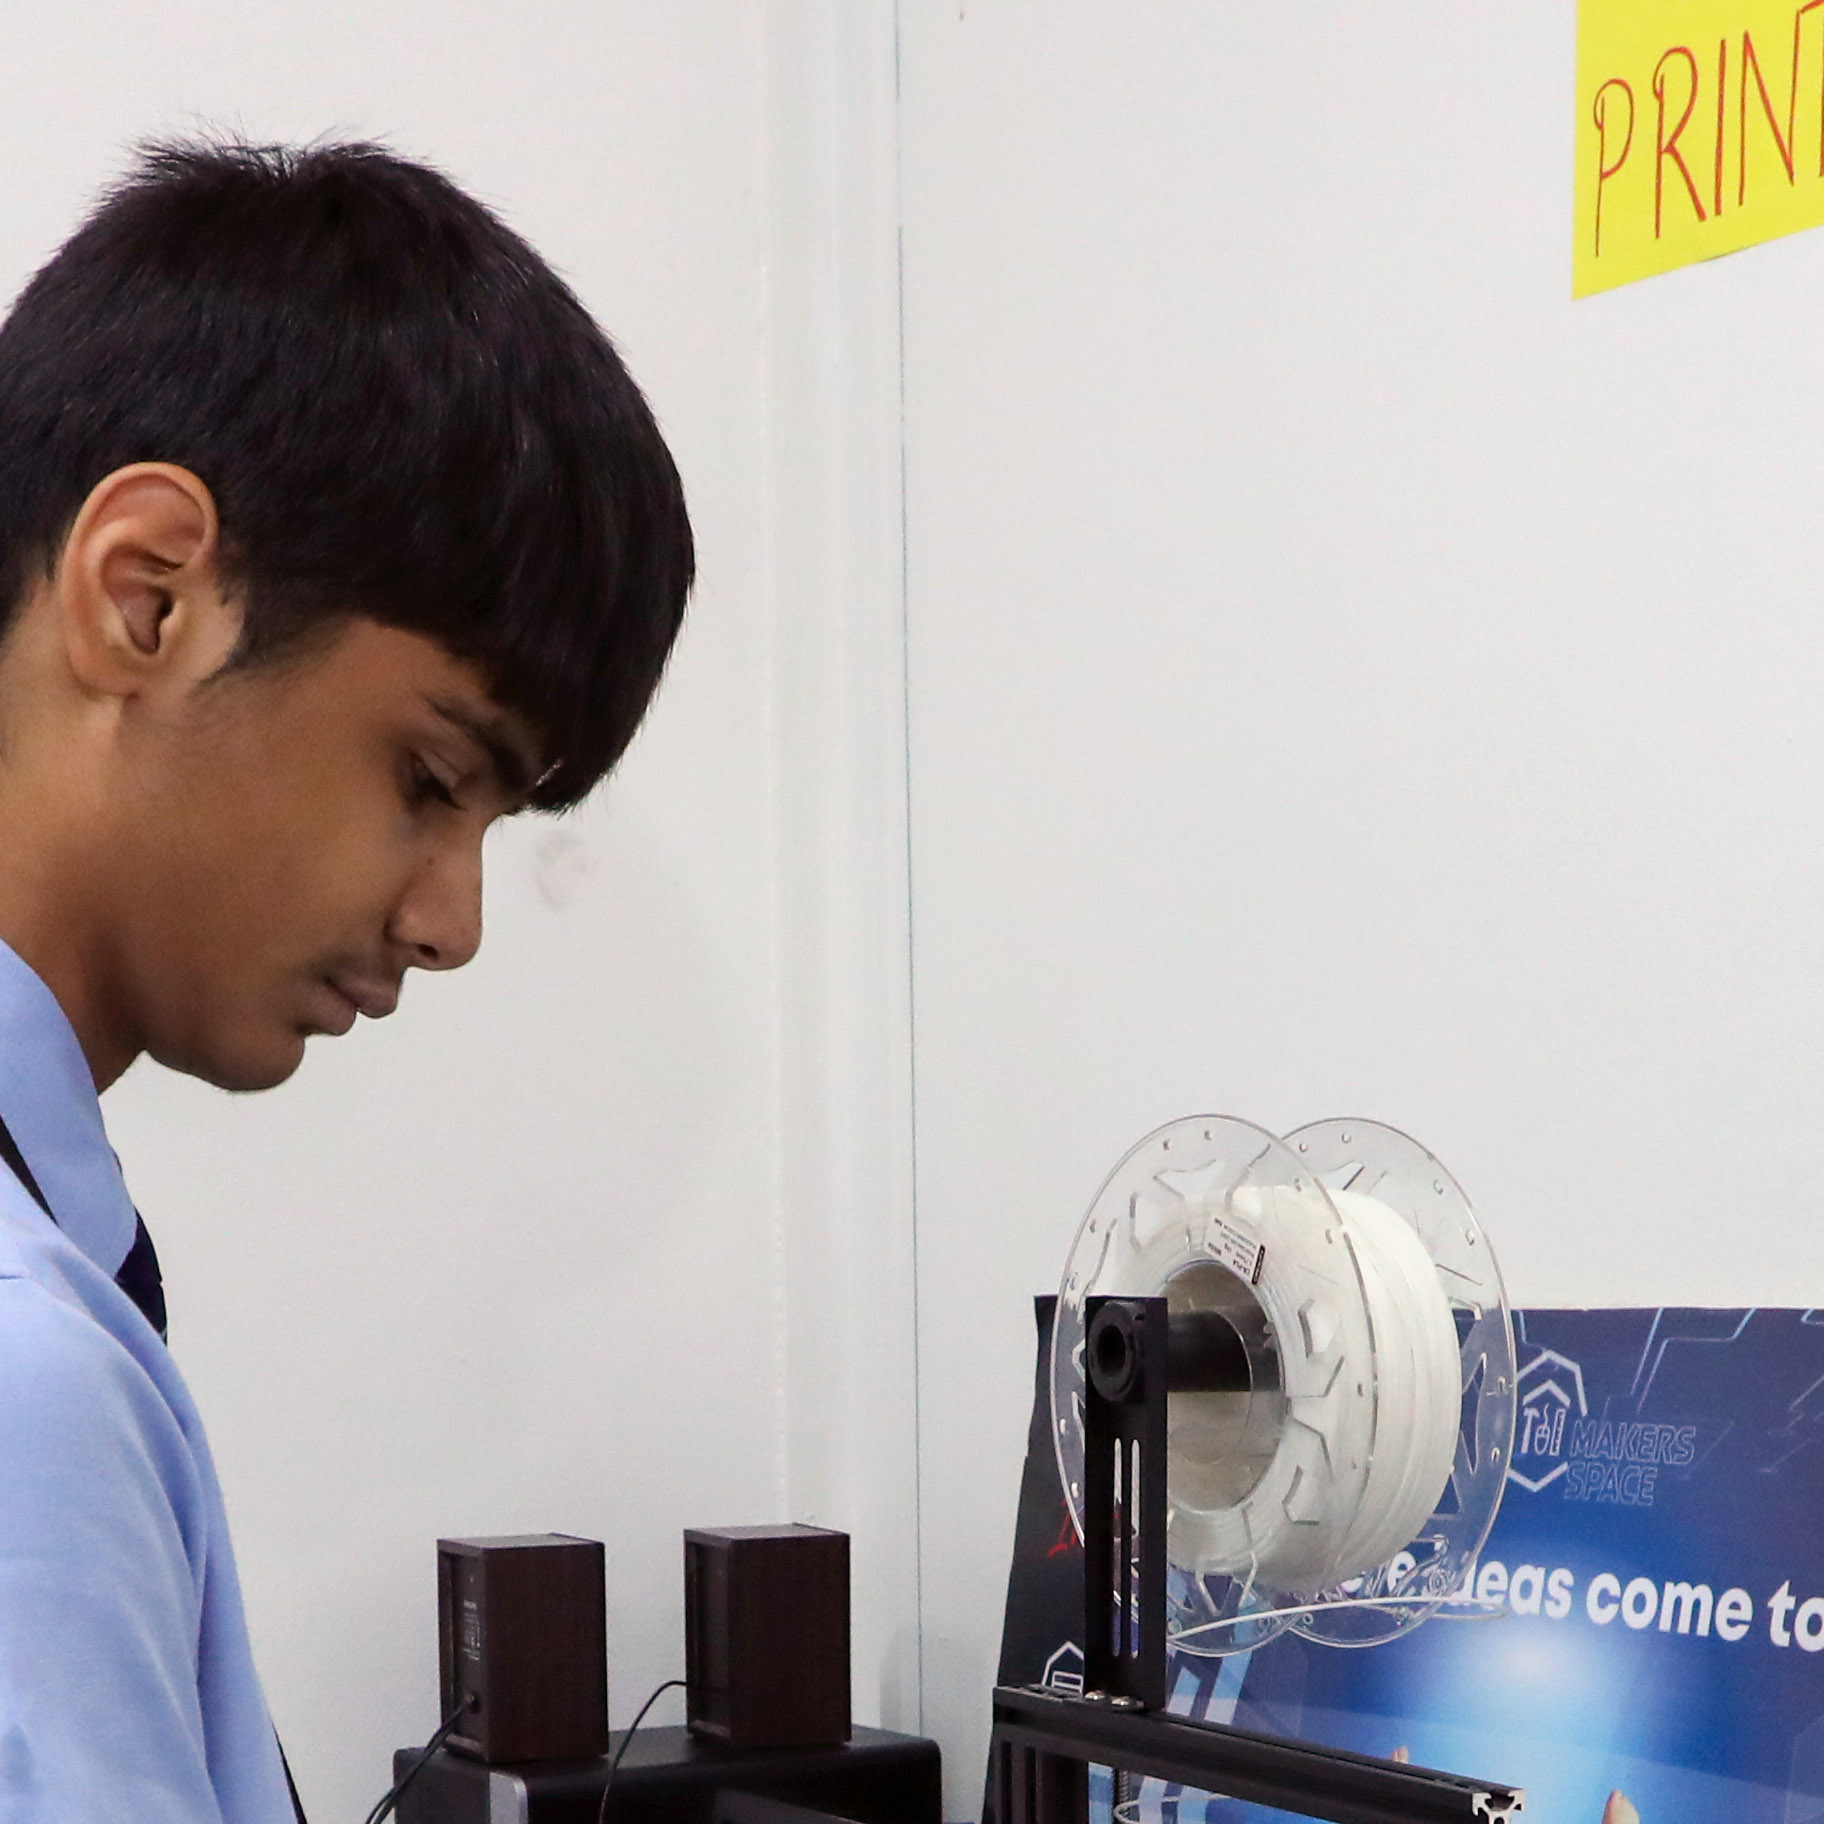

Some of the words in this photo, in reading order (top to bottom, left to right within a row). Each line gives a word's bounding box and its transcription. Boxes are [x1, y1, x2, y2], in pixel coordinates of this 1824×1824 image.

[1570, 1420, 1696, 1465] MAKERS
[1564, 1461, 1658, 1506] SPACE
[1586, 1572, 1753, 1642] come
